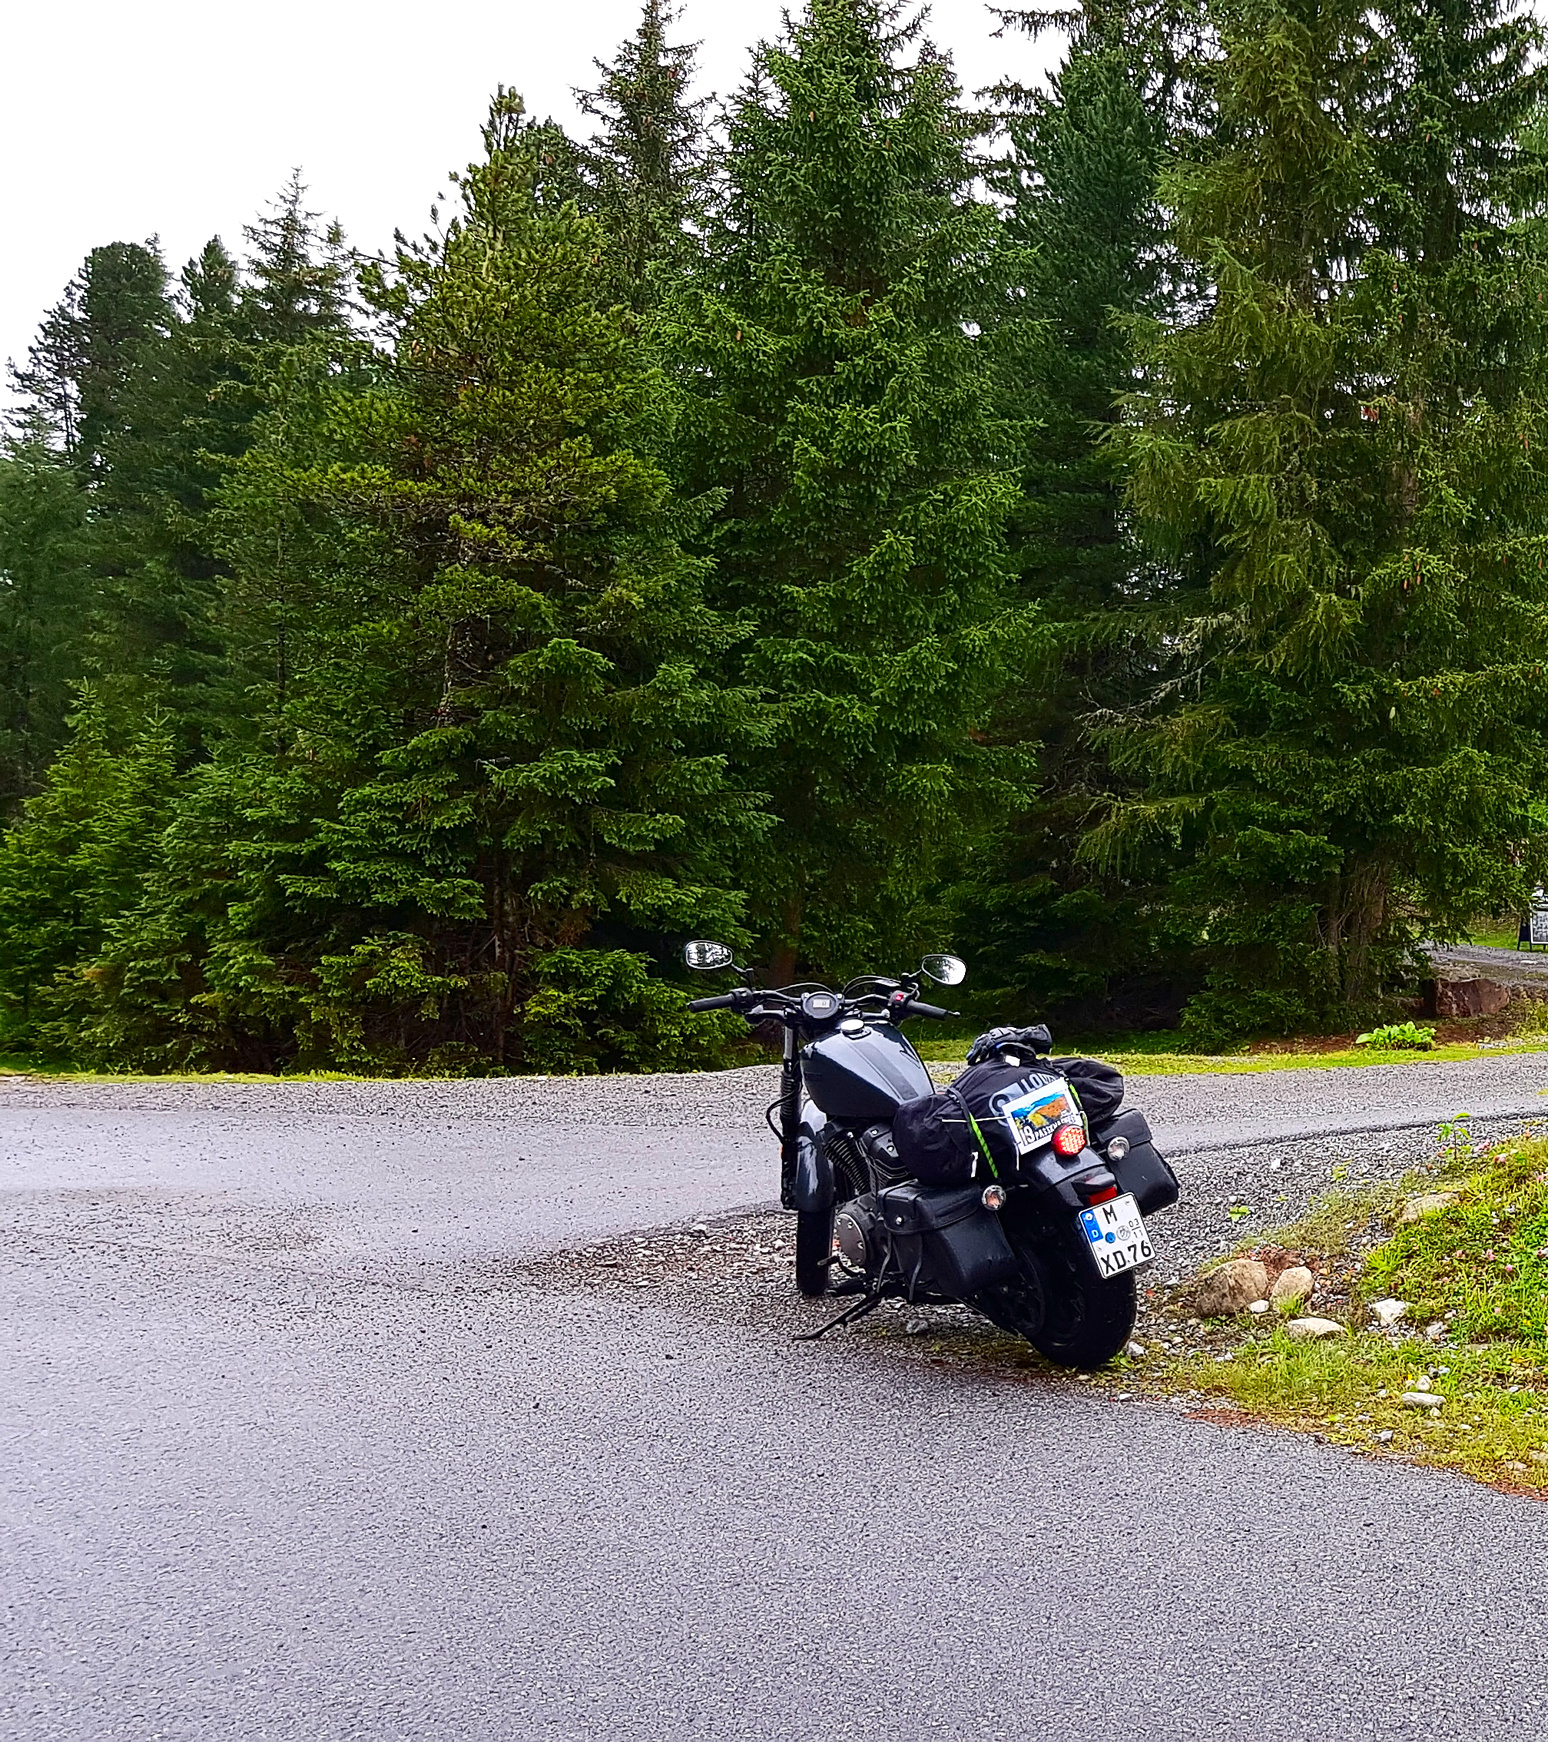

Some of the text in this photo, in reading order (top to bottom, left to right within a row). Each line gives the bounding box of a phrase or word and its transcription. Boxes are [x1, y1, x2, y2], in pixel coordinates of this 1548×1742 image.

[1103, 1205, 1118, 1225] M
[1091, 1229, 1099, 1239] D
[1101, 1240, 1152, 1275] XD 76
